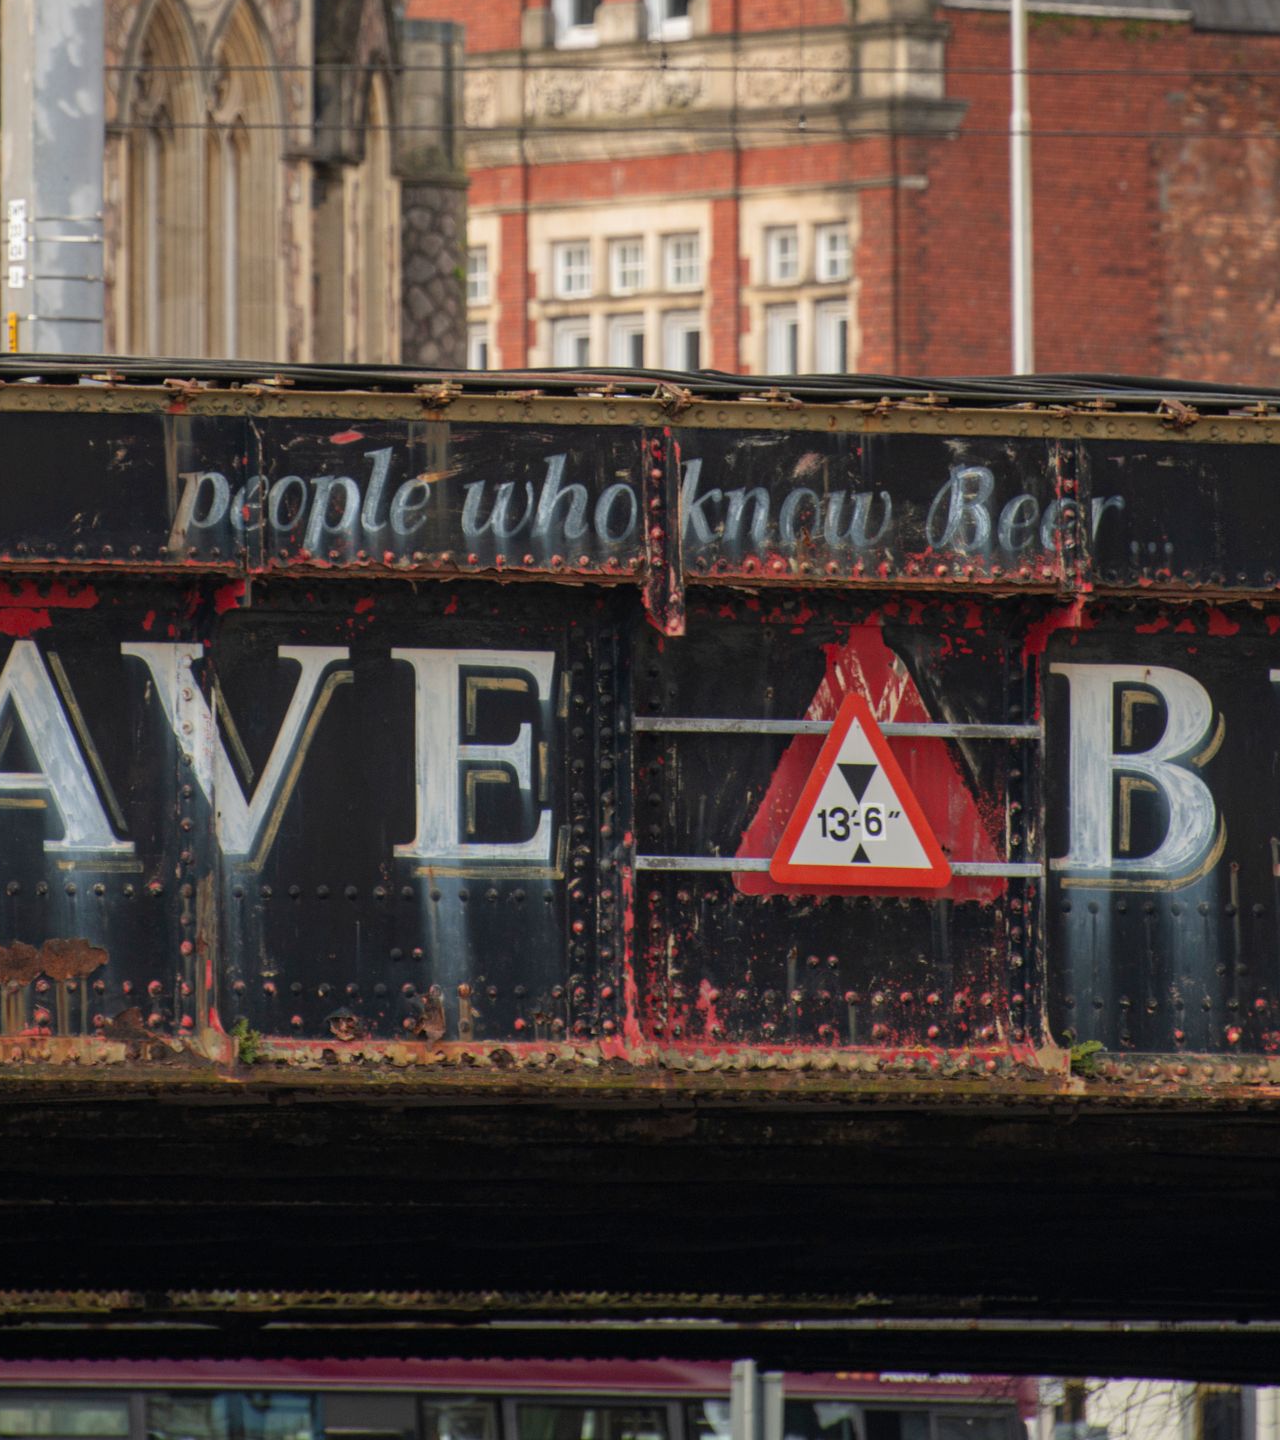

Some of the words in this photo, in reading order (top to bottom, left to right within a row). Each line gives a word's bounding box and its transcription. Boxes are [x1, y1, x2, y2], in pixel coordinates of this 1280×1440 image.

[168, 446, 431, 552] people
[460, 453, 638, 541] who
[680, 457, 892, 547] know
